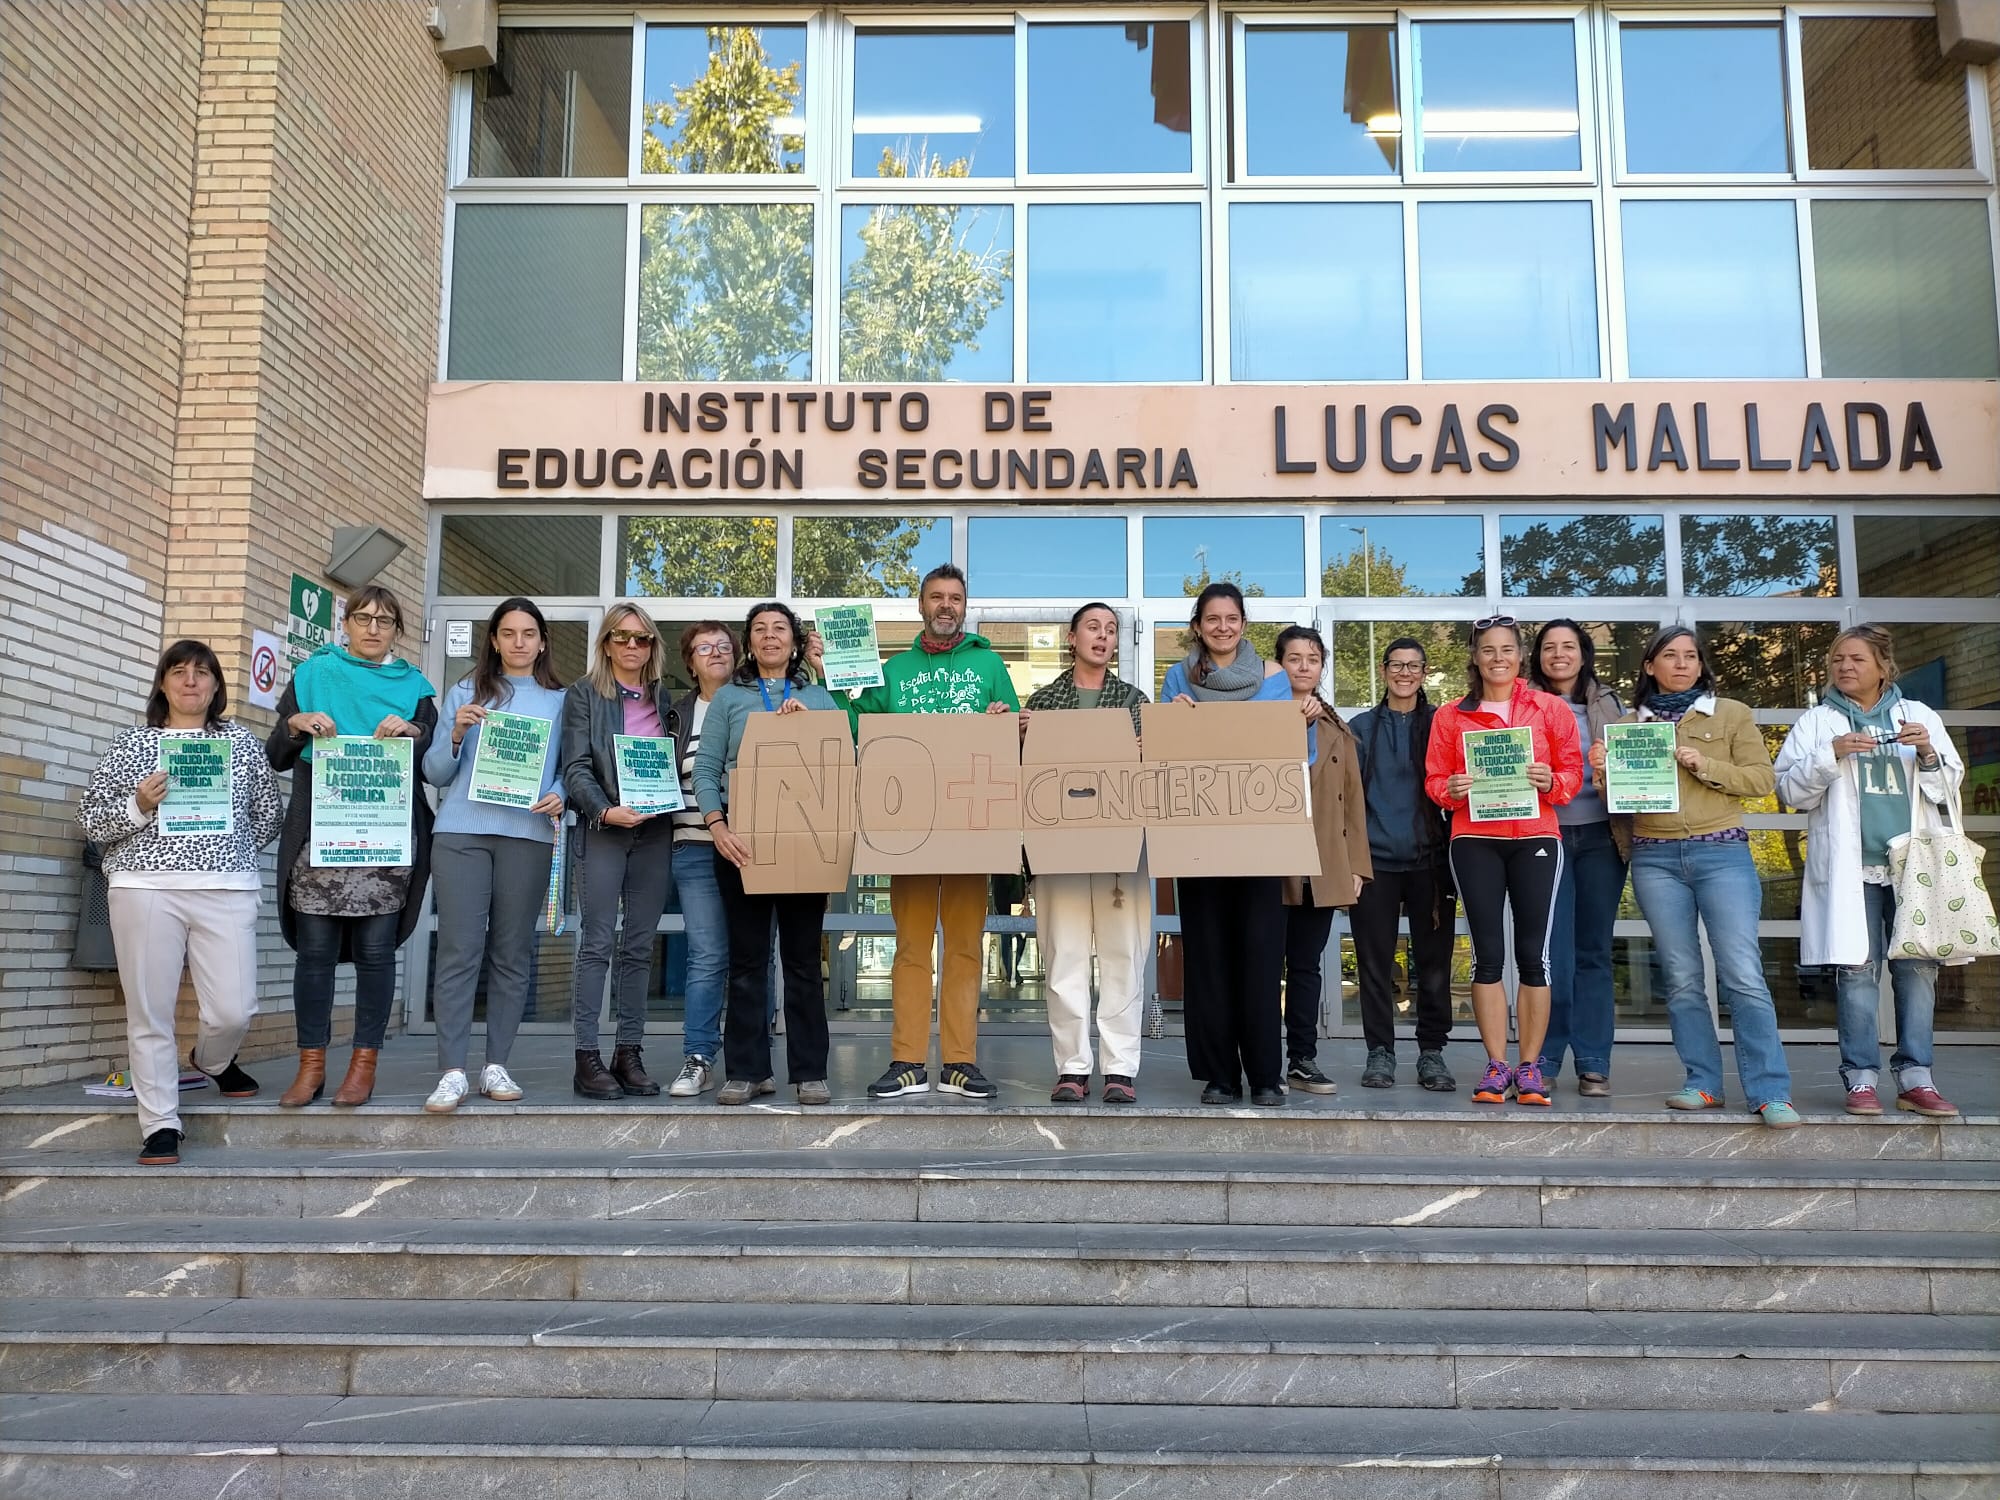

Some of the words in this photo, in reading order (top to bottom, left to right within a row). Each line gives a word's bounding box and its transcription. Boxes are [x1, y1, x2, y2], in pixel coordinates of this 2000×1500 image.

[643, 391, 930, 432] INSTITUTO
[985, 391, 1053, 431] DE
[1274, 403, 1521, 474] LUCAS
[1591, 401, 1943, 472] MALLADA
[497, 438, 803, 489] EDUCACIÓN
[857, 449, 1198, 489] SECUNDARIA
[833, 609, 857, 619] DINERO
[851, 619, 868, 628] PARA
[305, 622, 325, 645] DEA
[825, 631, 833, 640] LA
[900, 671, 940, 692] ESCUELA
[911, 695, 926, 707] DE
[504, 718, 531, 731] DINERO
[488, 737, 497, 747] LA
[521, 731, 540, 743] PARA
[1484, 734, 1511, 745] DINERO
[182, 743, 210, 754] DINERO
[344, 743, 384, 757] DINERO
[633, 741, 657, 750] DINERO
[1505, 744, 1525, 754] PARA
[203, 755, 223, 764] PARA
[651, 751, 668, 760] PARA
[373, 759, 401, 772] PARA
[625, 759, 633, 768] LA
[1474, 758, 1484, 767] LA
[169, 766, 178, 776] LA
[326, 773, 339, 786] LA
[752, 735, 937, 866] NO
[1024, 762, 1303, 826] CONCIERTOS
